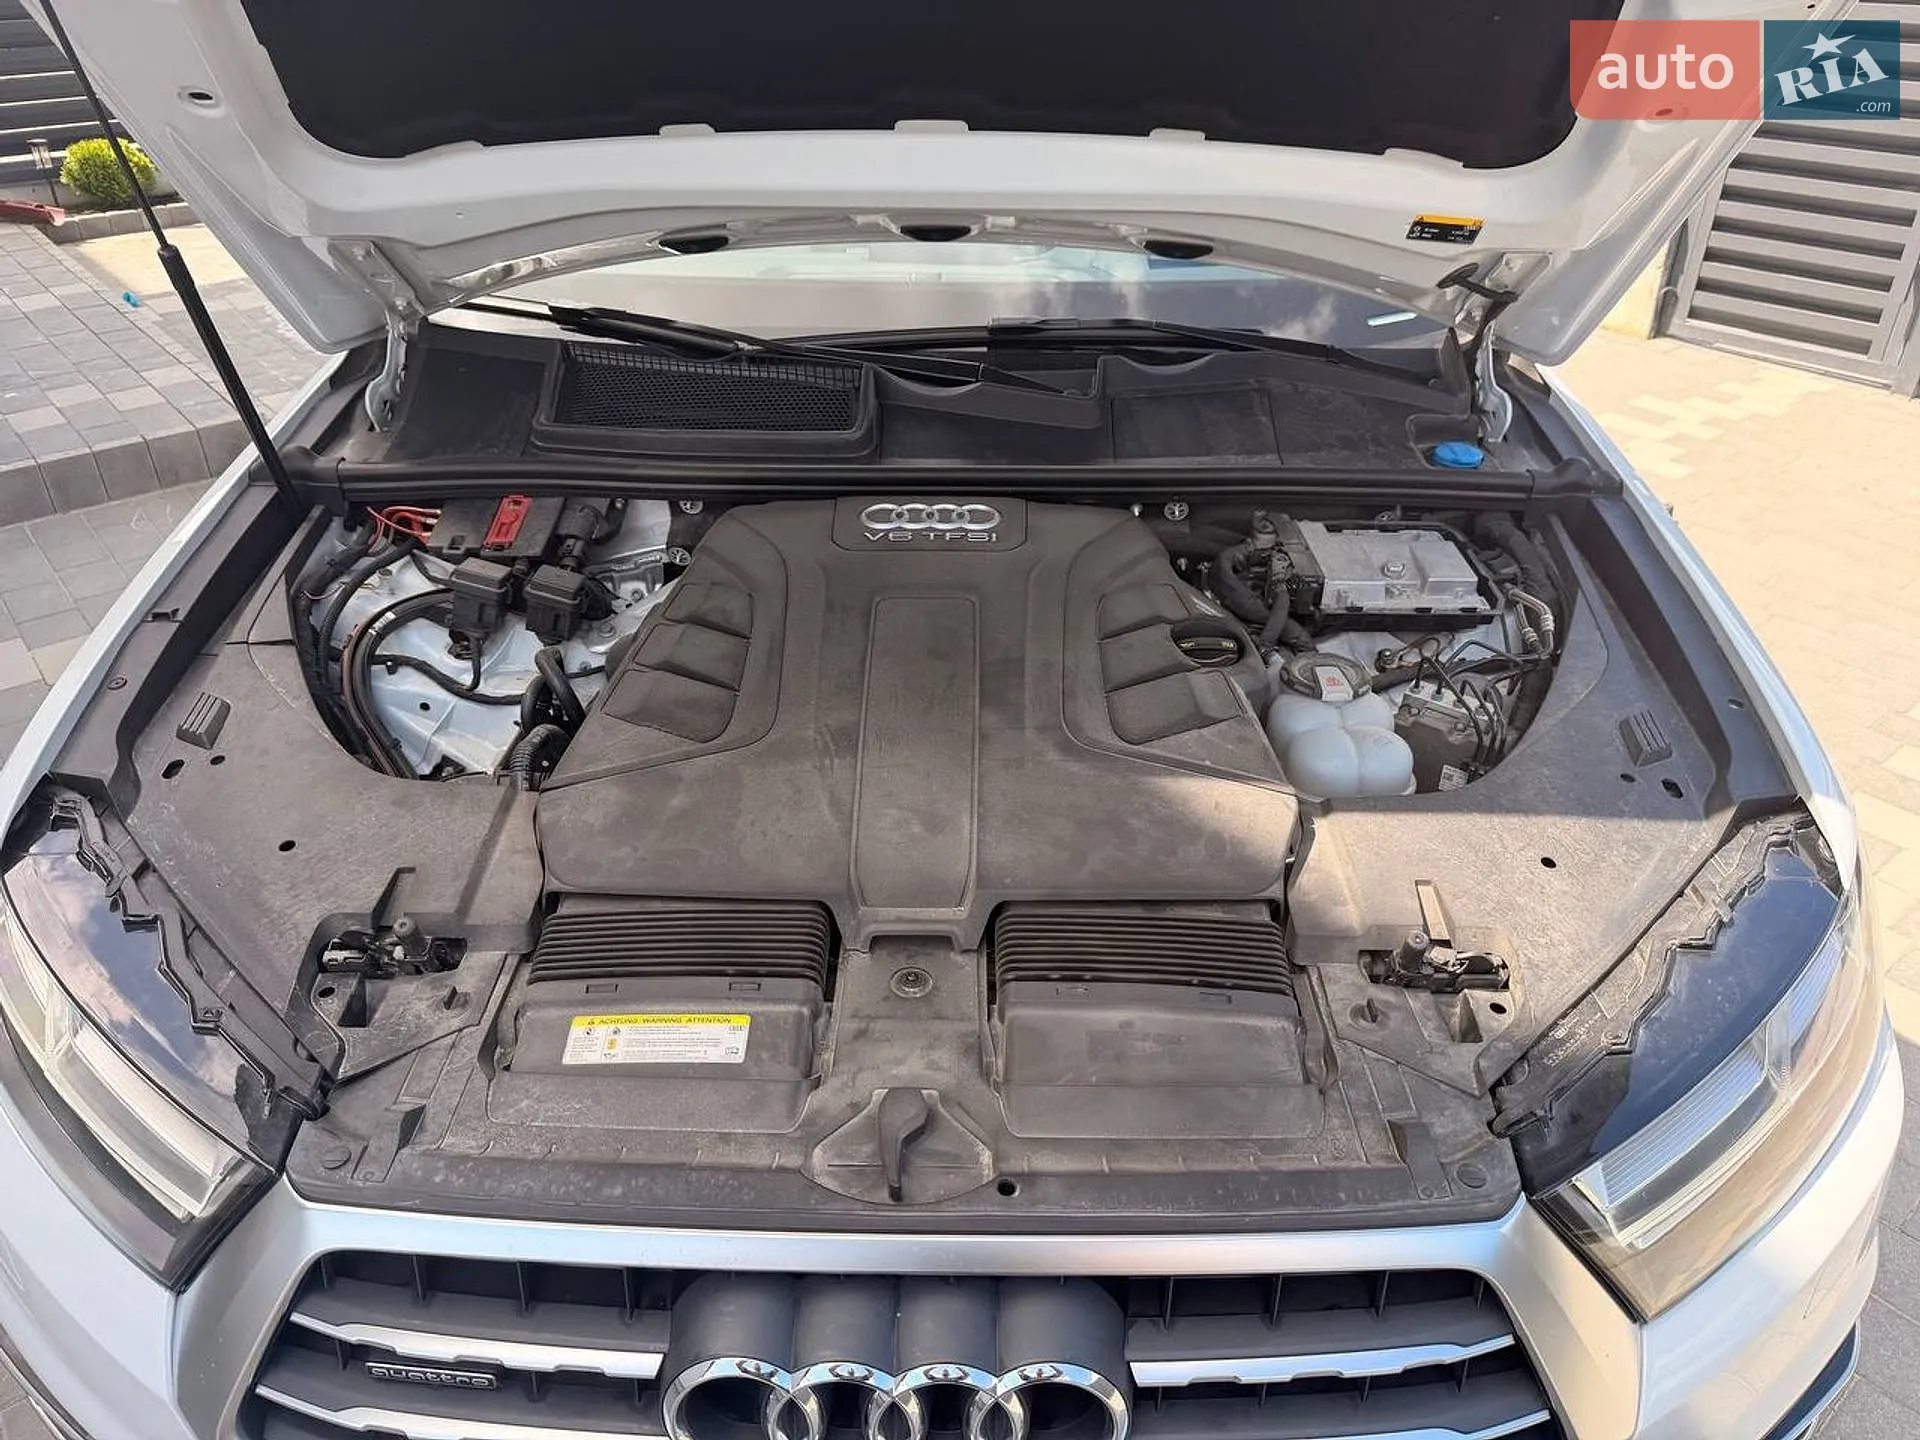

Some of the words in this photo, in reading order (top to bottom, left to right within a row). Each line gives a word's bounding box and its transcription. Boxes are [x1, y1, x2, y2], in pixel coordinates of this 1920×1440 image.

[863, 531, 913, 542] V6
[922, 531, 997, 542] TFSI
[598, 1017, 638, 1025] ACHTUNG
[371, 1367, 489, 1386] quattro
